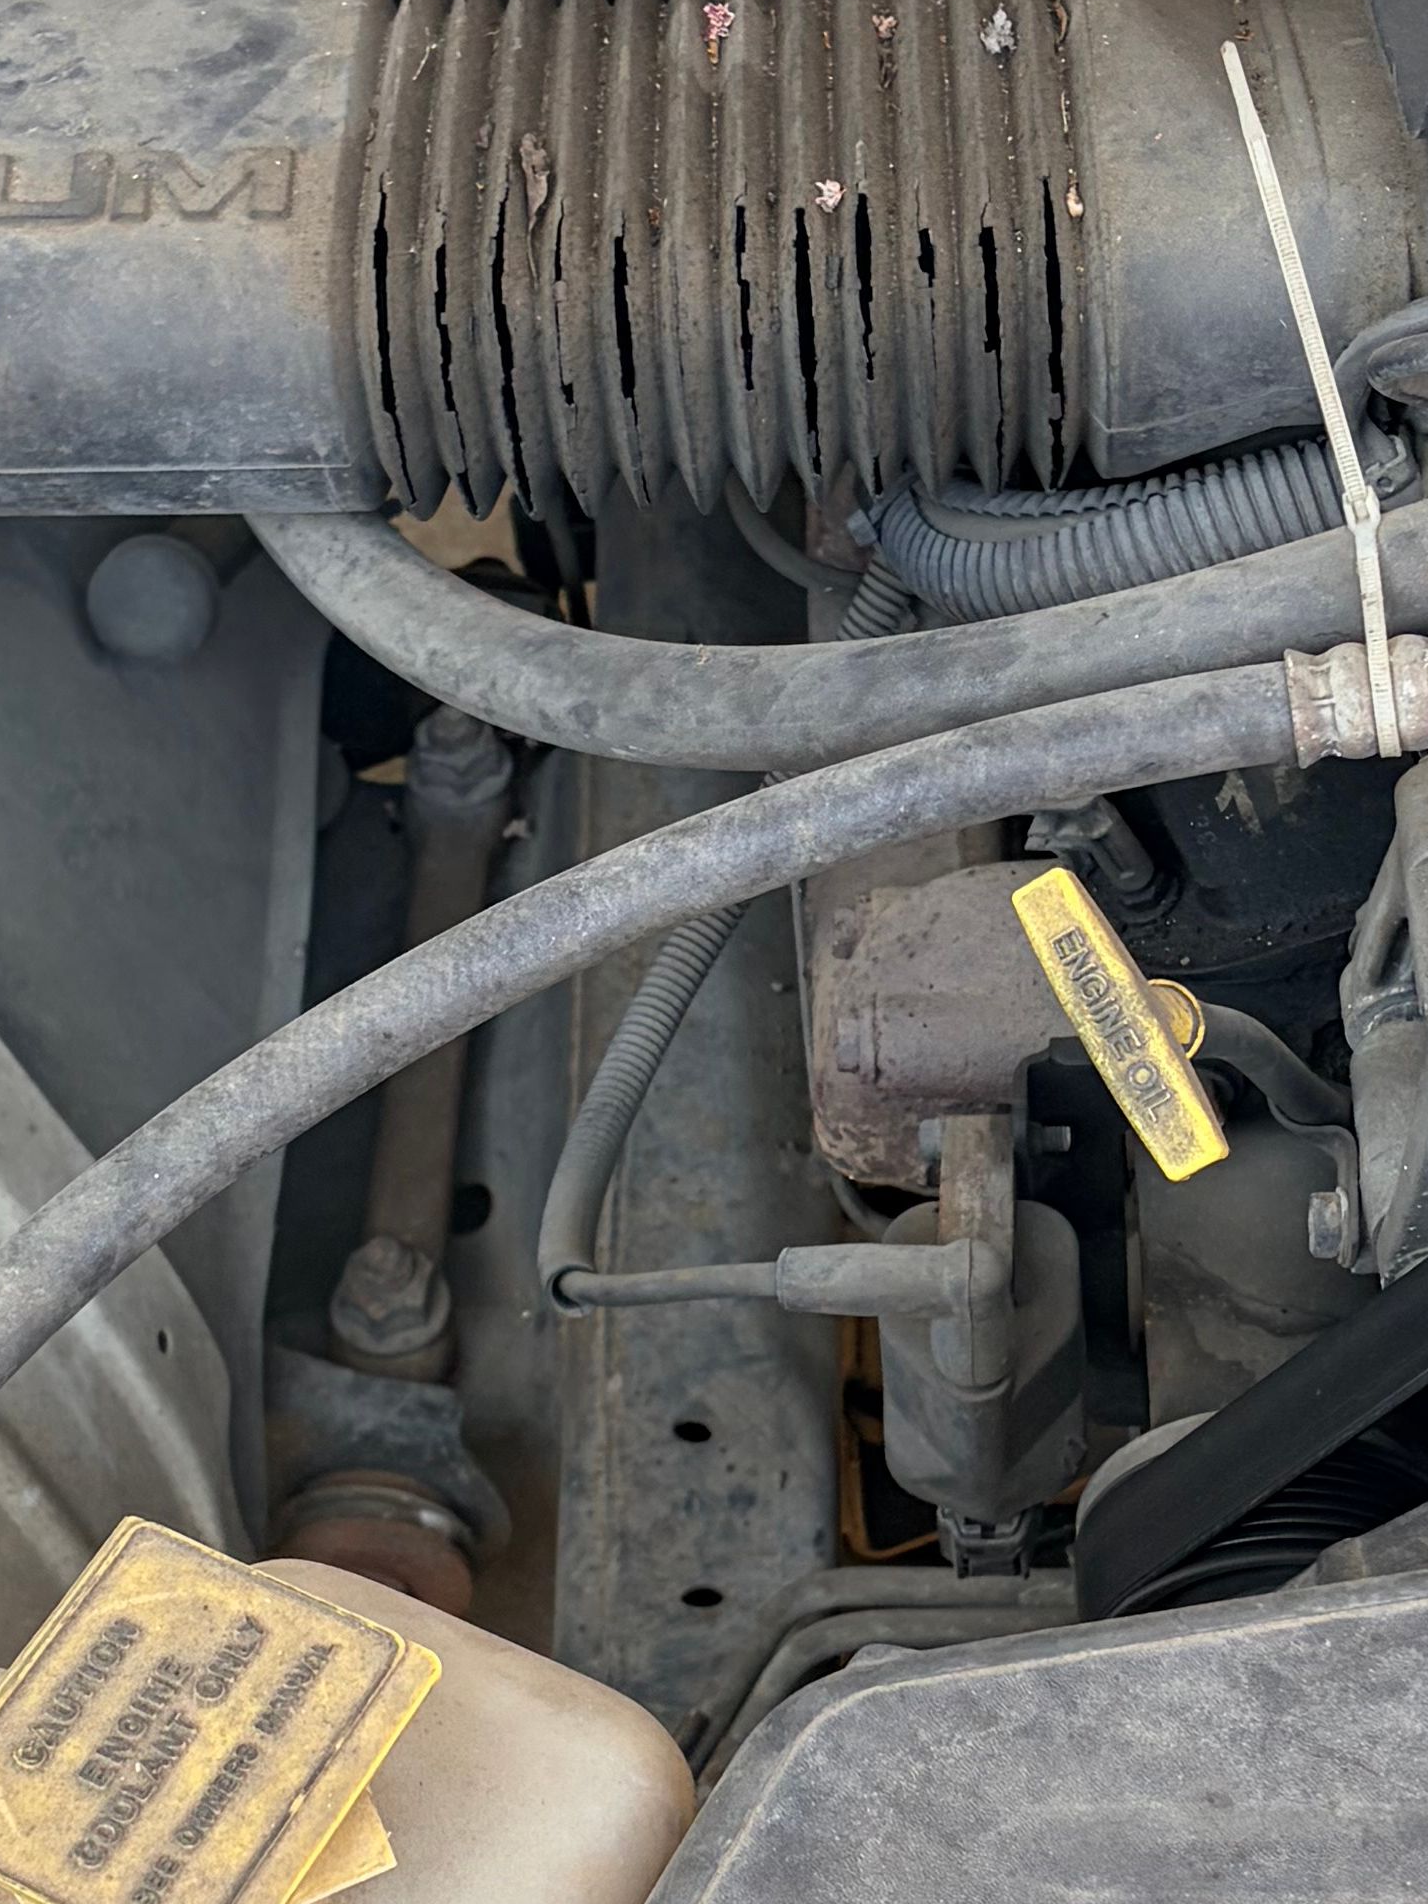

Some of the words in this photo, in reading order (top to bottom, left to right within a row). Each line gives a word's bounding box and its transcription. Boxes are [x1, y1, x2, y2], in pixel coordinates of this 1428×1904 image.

[1050, 925, 1144, 1062] ENGINE
[1127, 1060, 1179, 1124] OIL
[12, 1616, 144, 1772] CAUTION
[68, 1712, 198, 1872] COOLANT
[193, 1614, 267, 1709] ONLY
[75, 1653, 196, 1790] ENGINE
[253, 1641, 342, 1737] MANUAL
